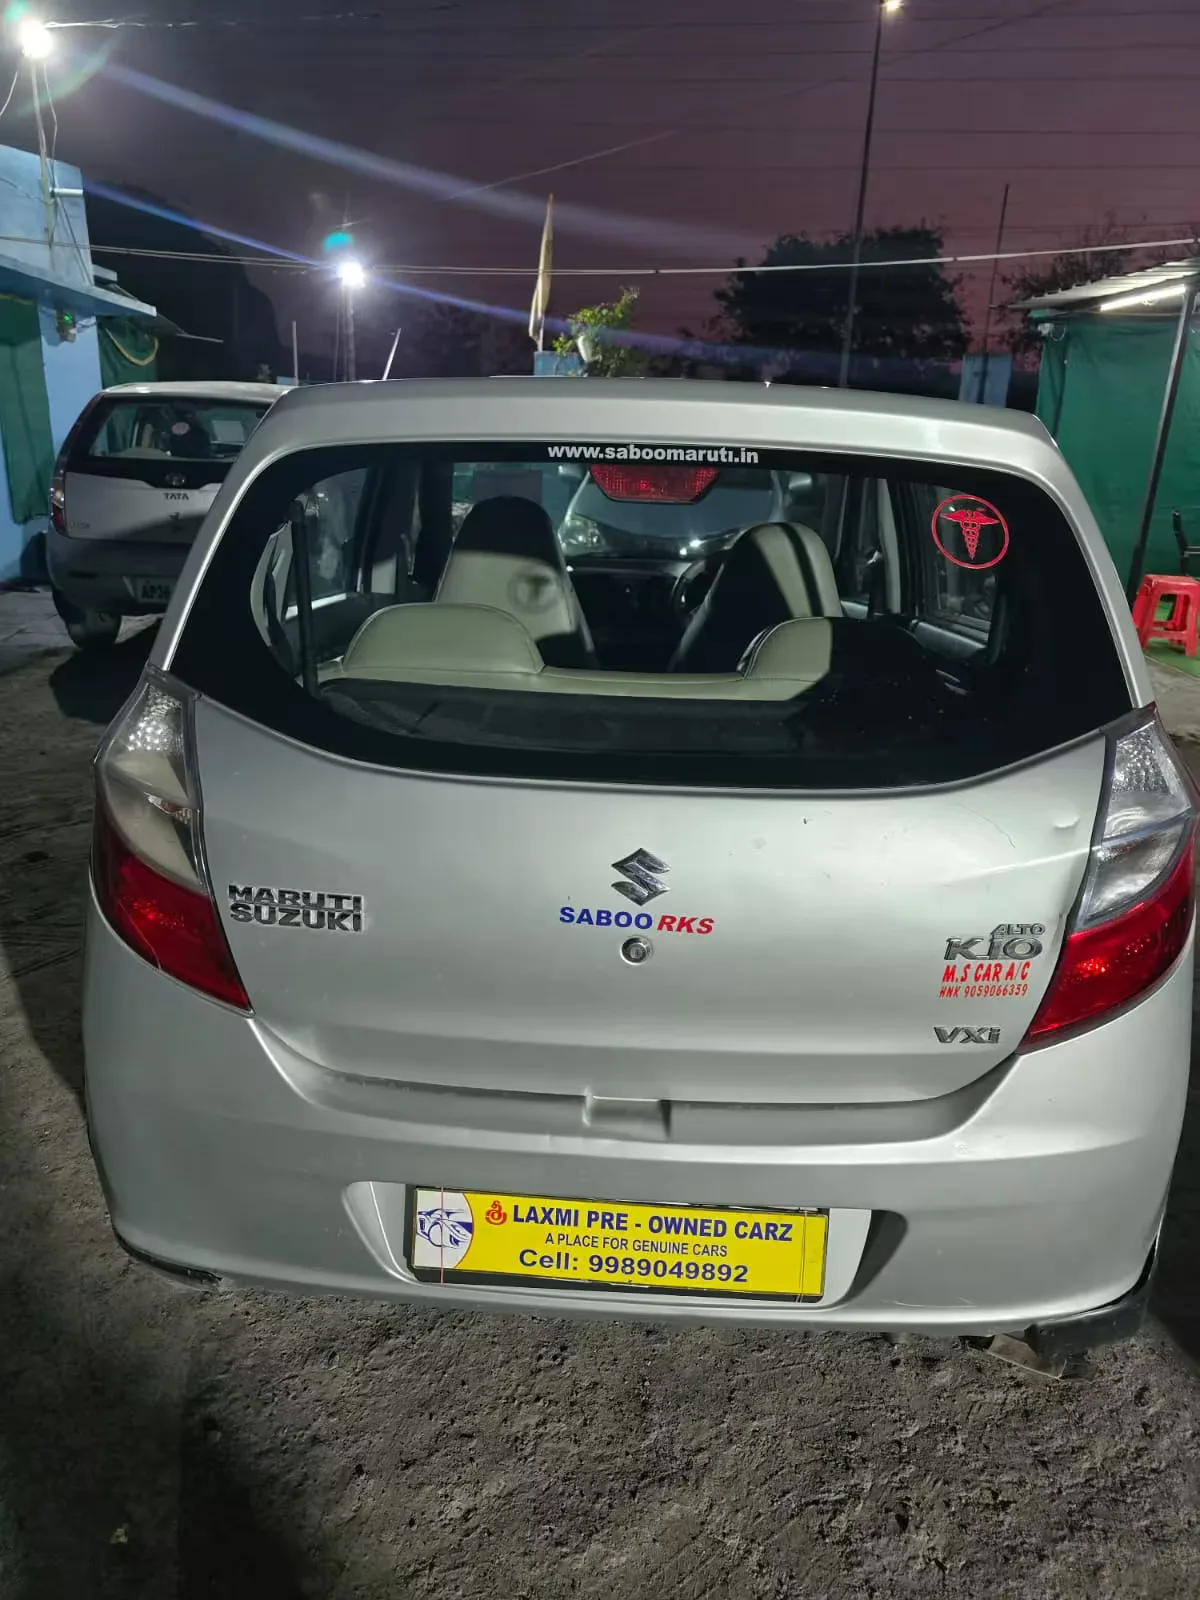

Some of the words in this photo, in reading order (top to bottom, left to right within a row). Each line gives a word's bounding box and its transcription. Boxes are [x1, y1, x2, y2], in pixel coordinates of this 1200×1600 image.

[548, 444, 759, 464] www.saboomaruti.in
[163, 492, 190, 501] TATA
[228, 884, 363, 913] MARUTI
[229, 902, 363, 932] SUZUKI
[559, 906, 653, 930] SABOO
[656, 914, 715, 935] RKS
[990, 923, 1046, 936] ALTO
[942, 963, 971, 983] M.S
[974, 962, 1003, 983] CAR
[1005, 961, 1031, 982] A/C
[939, 986, 962, 999] HNK
[964, 984, 1028, 998] 9059066359
[513, 1204, 579, 1228] LAXMI
[587, 1210, 629, 1231] PRE
[648, 1215, 727, 1238] OWNED
[734, 1220, 793, 1242] CARZ
[545, 1233, 554, 1245] A
[557, 1233, 599, 1249] PLACE
[602, 1236, 628, 1251] FOR
[632, 1239, 689, 1256] GENUINE
[692, 1243, 728, 1257] CARS
[519, 1248, 578, 1271] Cell:
[588, 1254, 748, 1283] 9989049892
